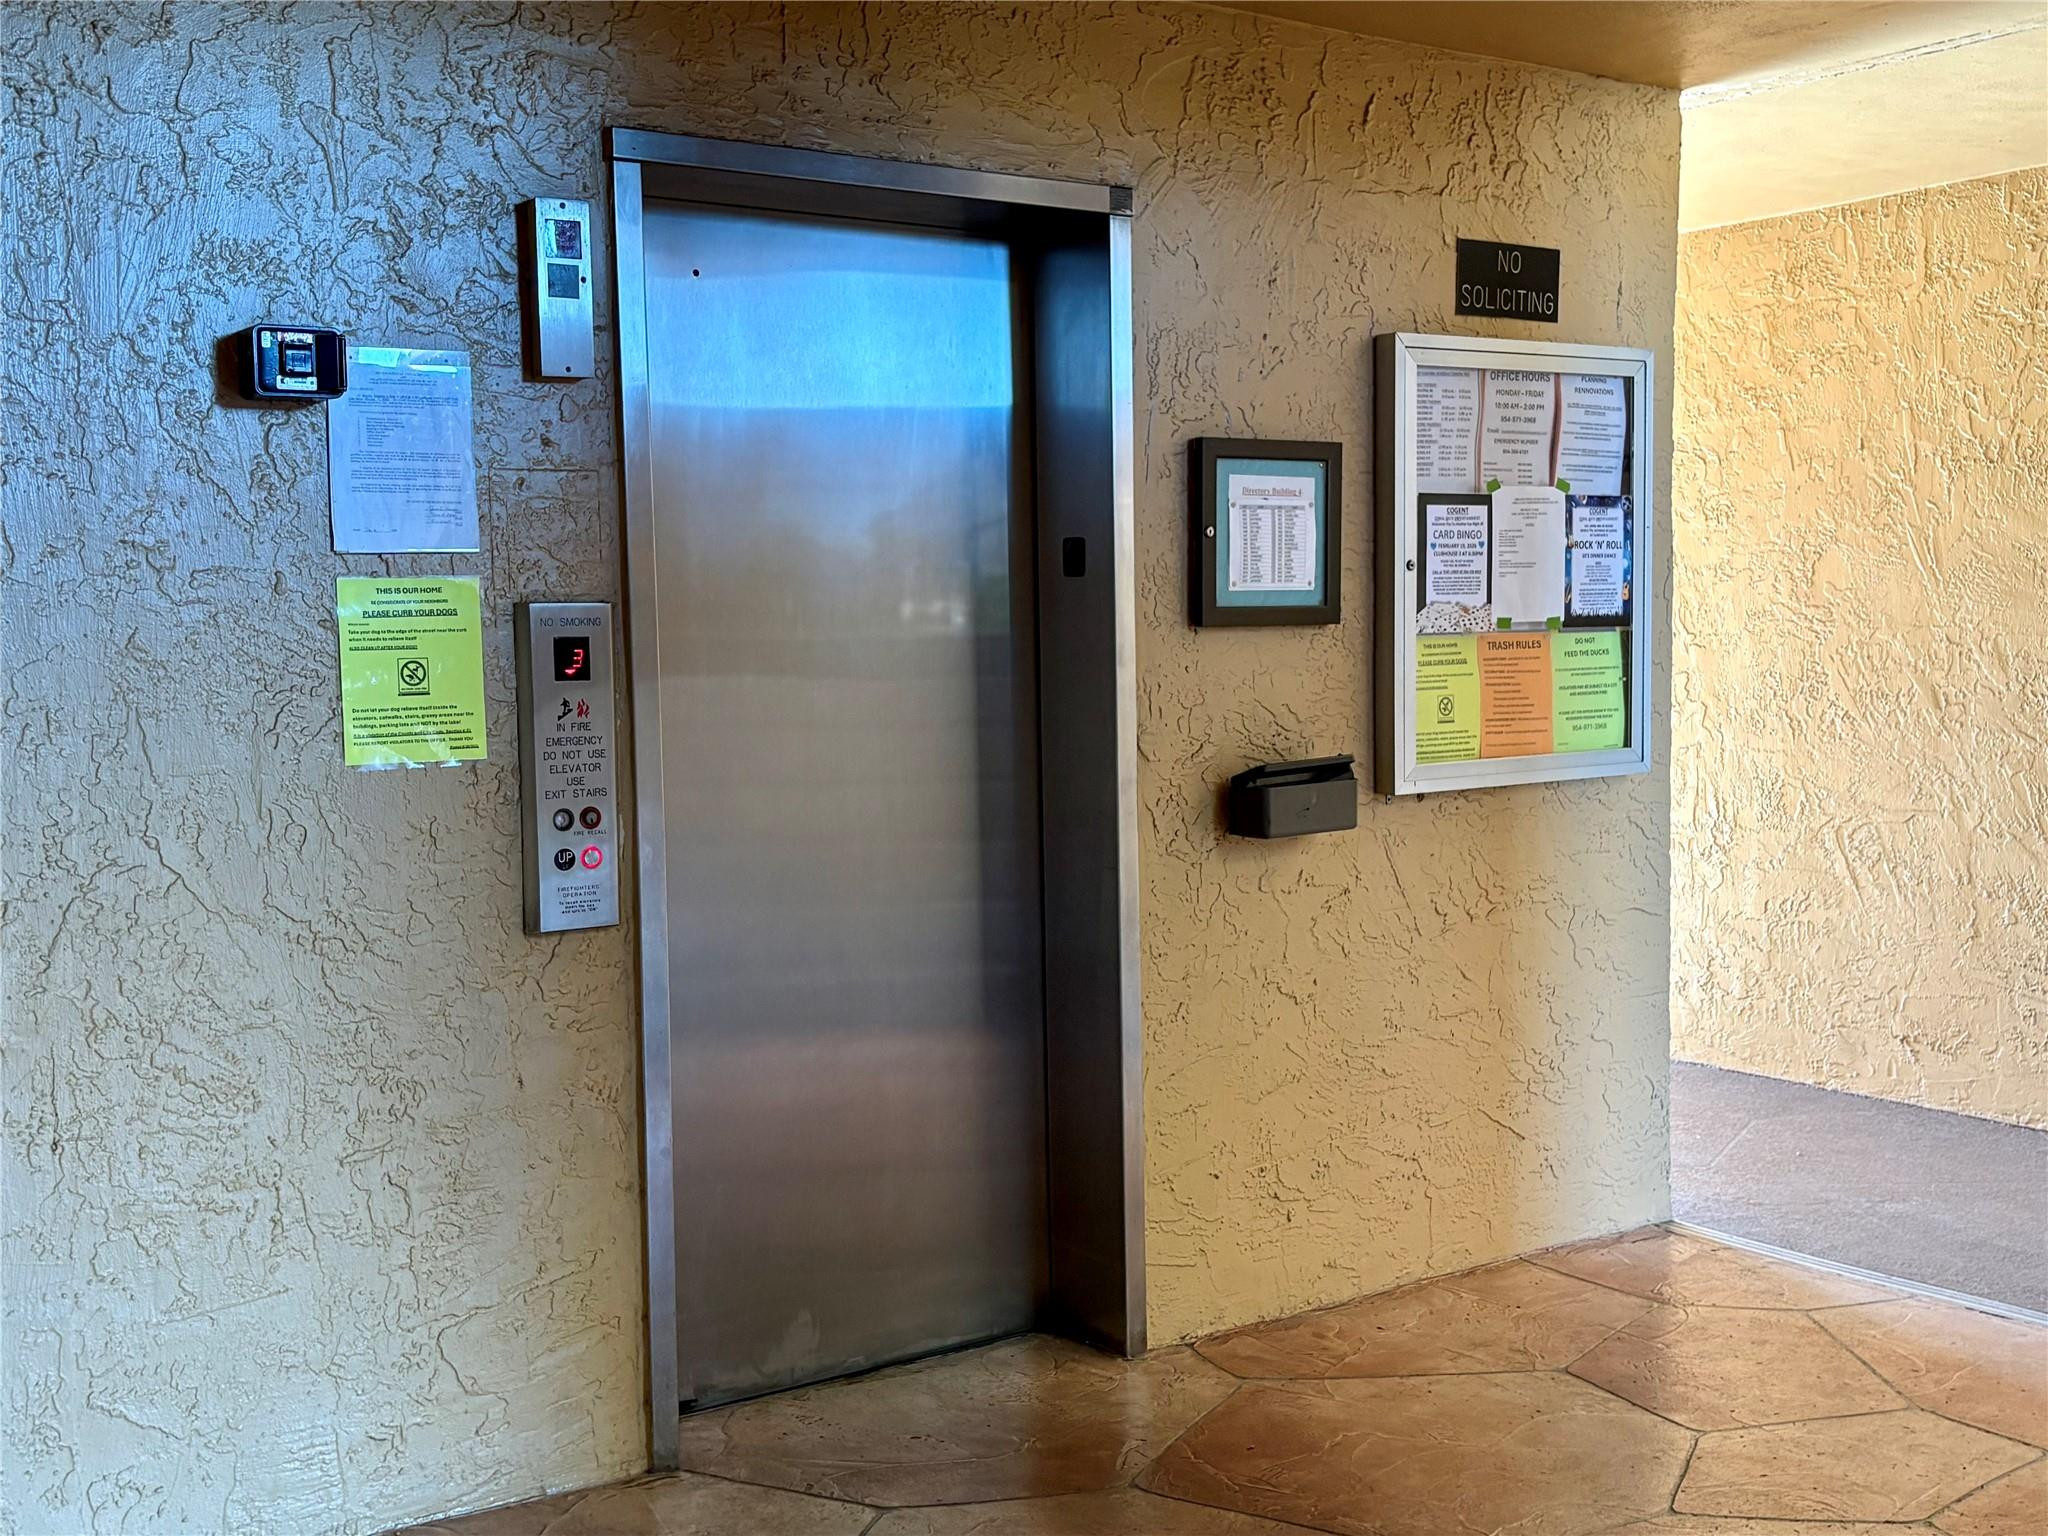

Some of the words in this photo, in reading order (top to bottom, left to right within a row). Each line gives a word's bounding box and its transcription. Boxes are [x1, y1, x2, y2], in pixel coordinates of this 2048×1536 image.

[1498, 250, 1522, 274] NO
[1461, 284, 1554, 315] SOLICITING
[1490, 371, 1520, 381] OFFICE
[1522, 372, 1550, 382] HOURS
[1574, 387, 1614, 396] RENNOVATIONS
[1242, 487, 1270, 496] Directory
[1272, 488, 1296, 496] Building
[1433, 530, 1455, 539] CARD
[1457, 530, 1482, 539] BINGO
[1574, 540, 1593, 549] ROCK
[1606, 541, 1622, 549] ROLL
[540, 618, 553, 627] NO
[560, 617, 601, 627] SMOKING
[1488, 641, 1514, 650] TRASH
[1516, 640, 1541, 649] RULES
[572, 648, 584, 668] 3
[556, 723, 565, 732] IN
[571, 722, 591, 731] FIRE
[546, 736, 603, 747] EMERGENCY
[543, 751, 556, 760] DO
[562, 750, 581, 760] NOT
[588, 749, 606, 758] USE
[550, 763, 601, 774] ELEVATOR
[567, 776, 585, 786] USE
[545, 790, 566, 800] EXIT
[573, 787, 607, 798] STAIRS
[558, 851, 573, 863] UP
